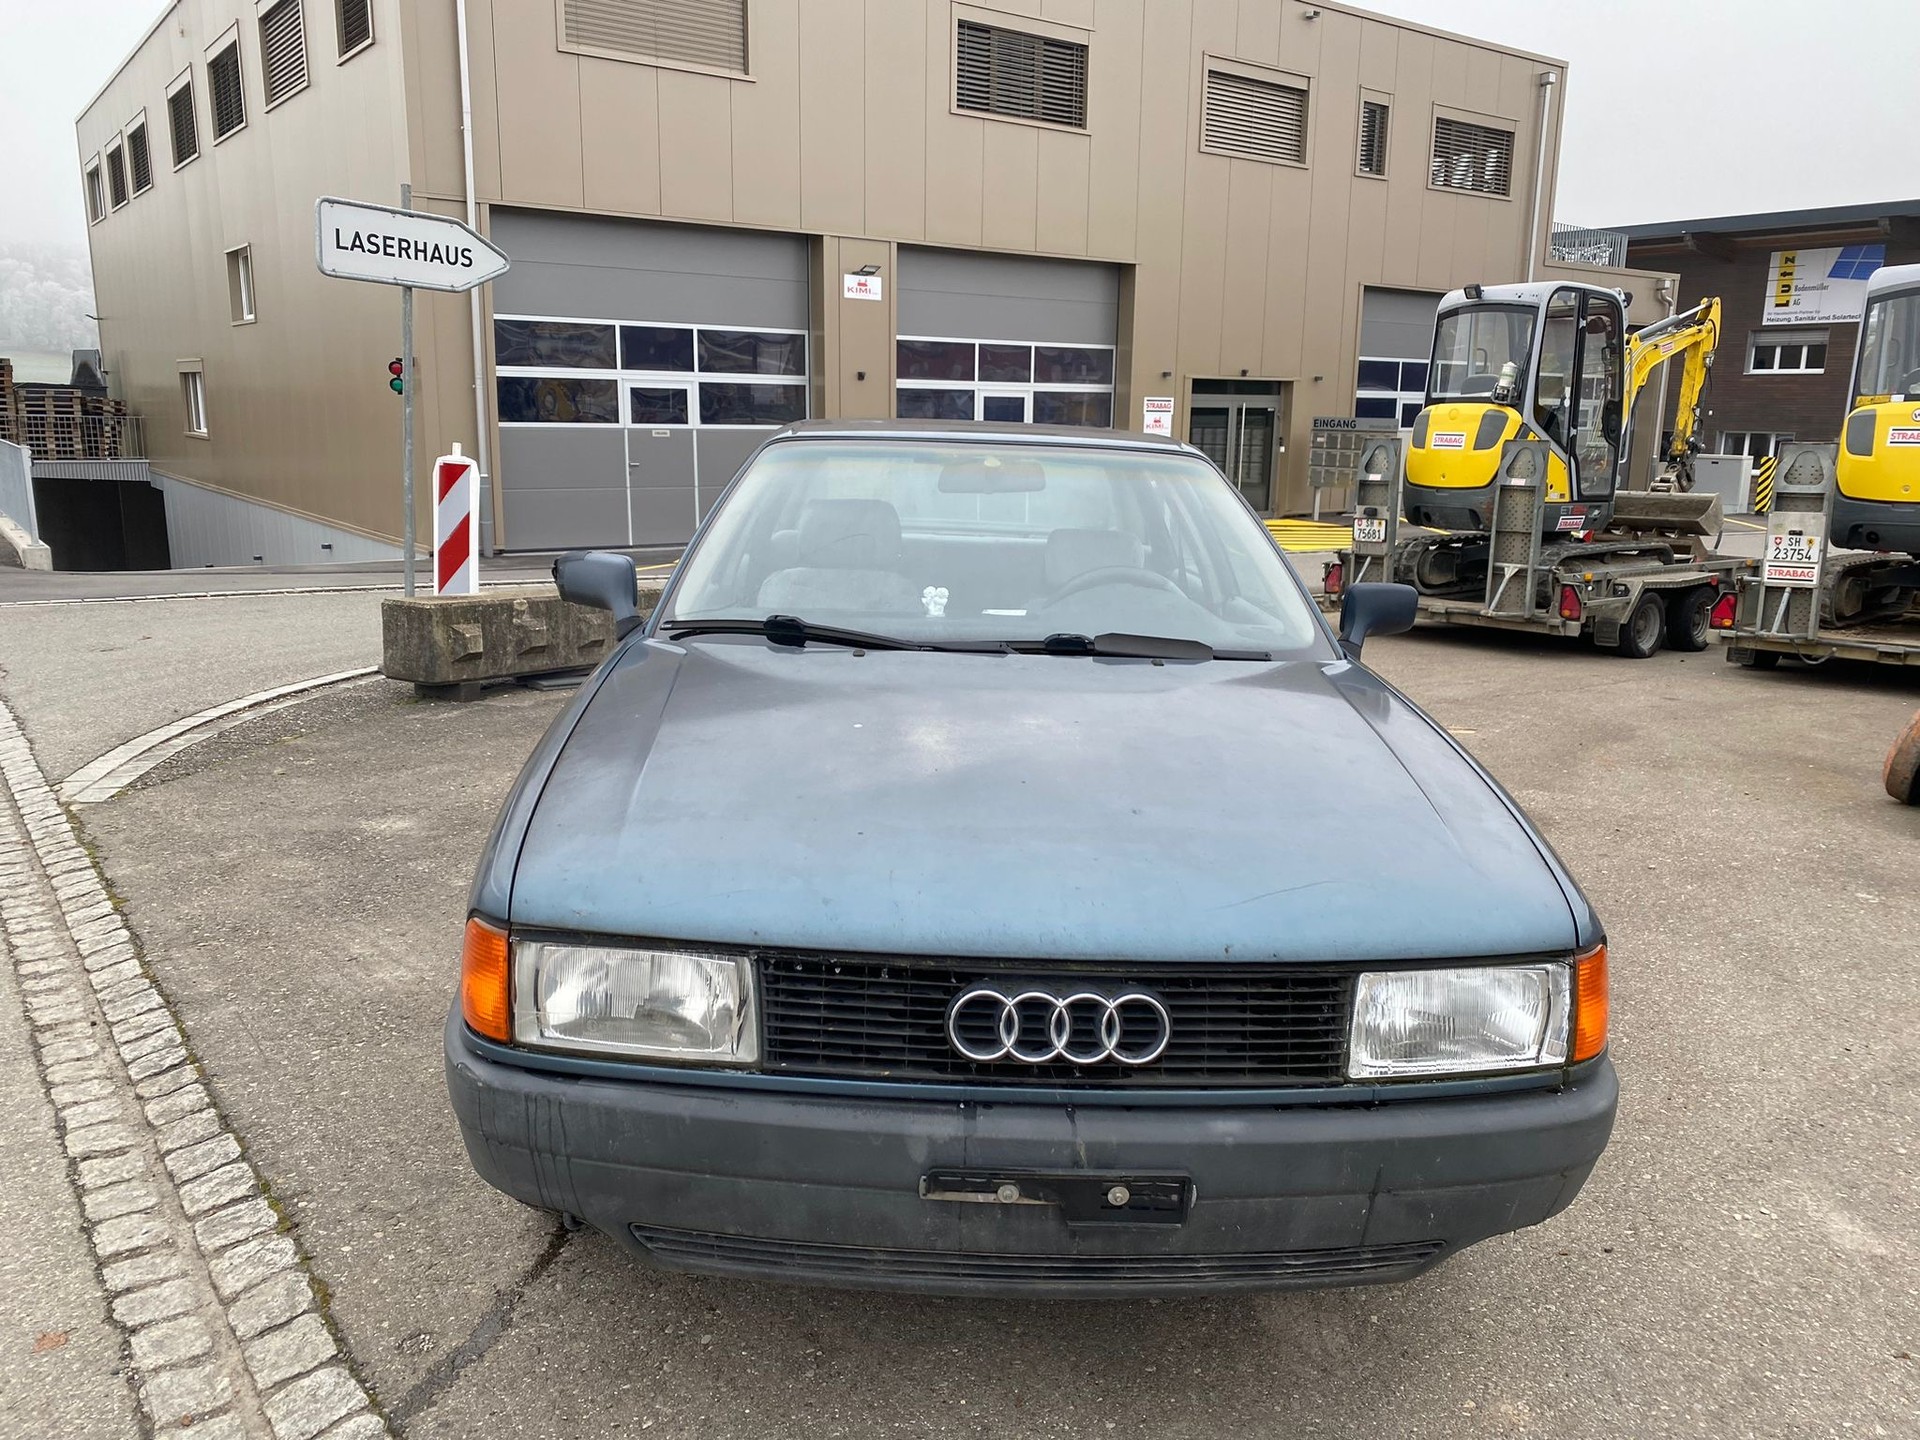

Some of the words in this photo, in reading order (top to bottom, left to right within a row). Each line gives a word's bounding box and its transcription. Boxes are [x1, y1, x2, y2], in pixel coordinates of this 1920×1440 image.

[335, 228, 473, 268] LASERHAUS
[847, 286, 872, 294] KIMI
[1793, 298, 1801, 306] AG
[1146, 402, 1172, 410] STRABAG
[1313, 418, 1357, 429] EINGANG
[1434, 436, 1463, 445] STRABAG
[1365, 518, 1375, 527] SH
[1357, 528, 1381, 539] 75681
[1788, 537, 1801, 547] SH
[1773, 546, 1812, 560] 23754
[1767, 568, 1815, 578] STRABAG
